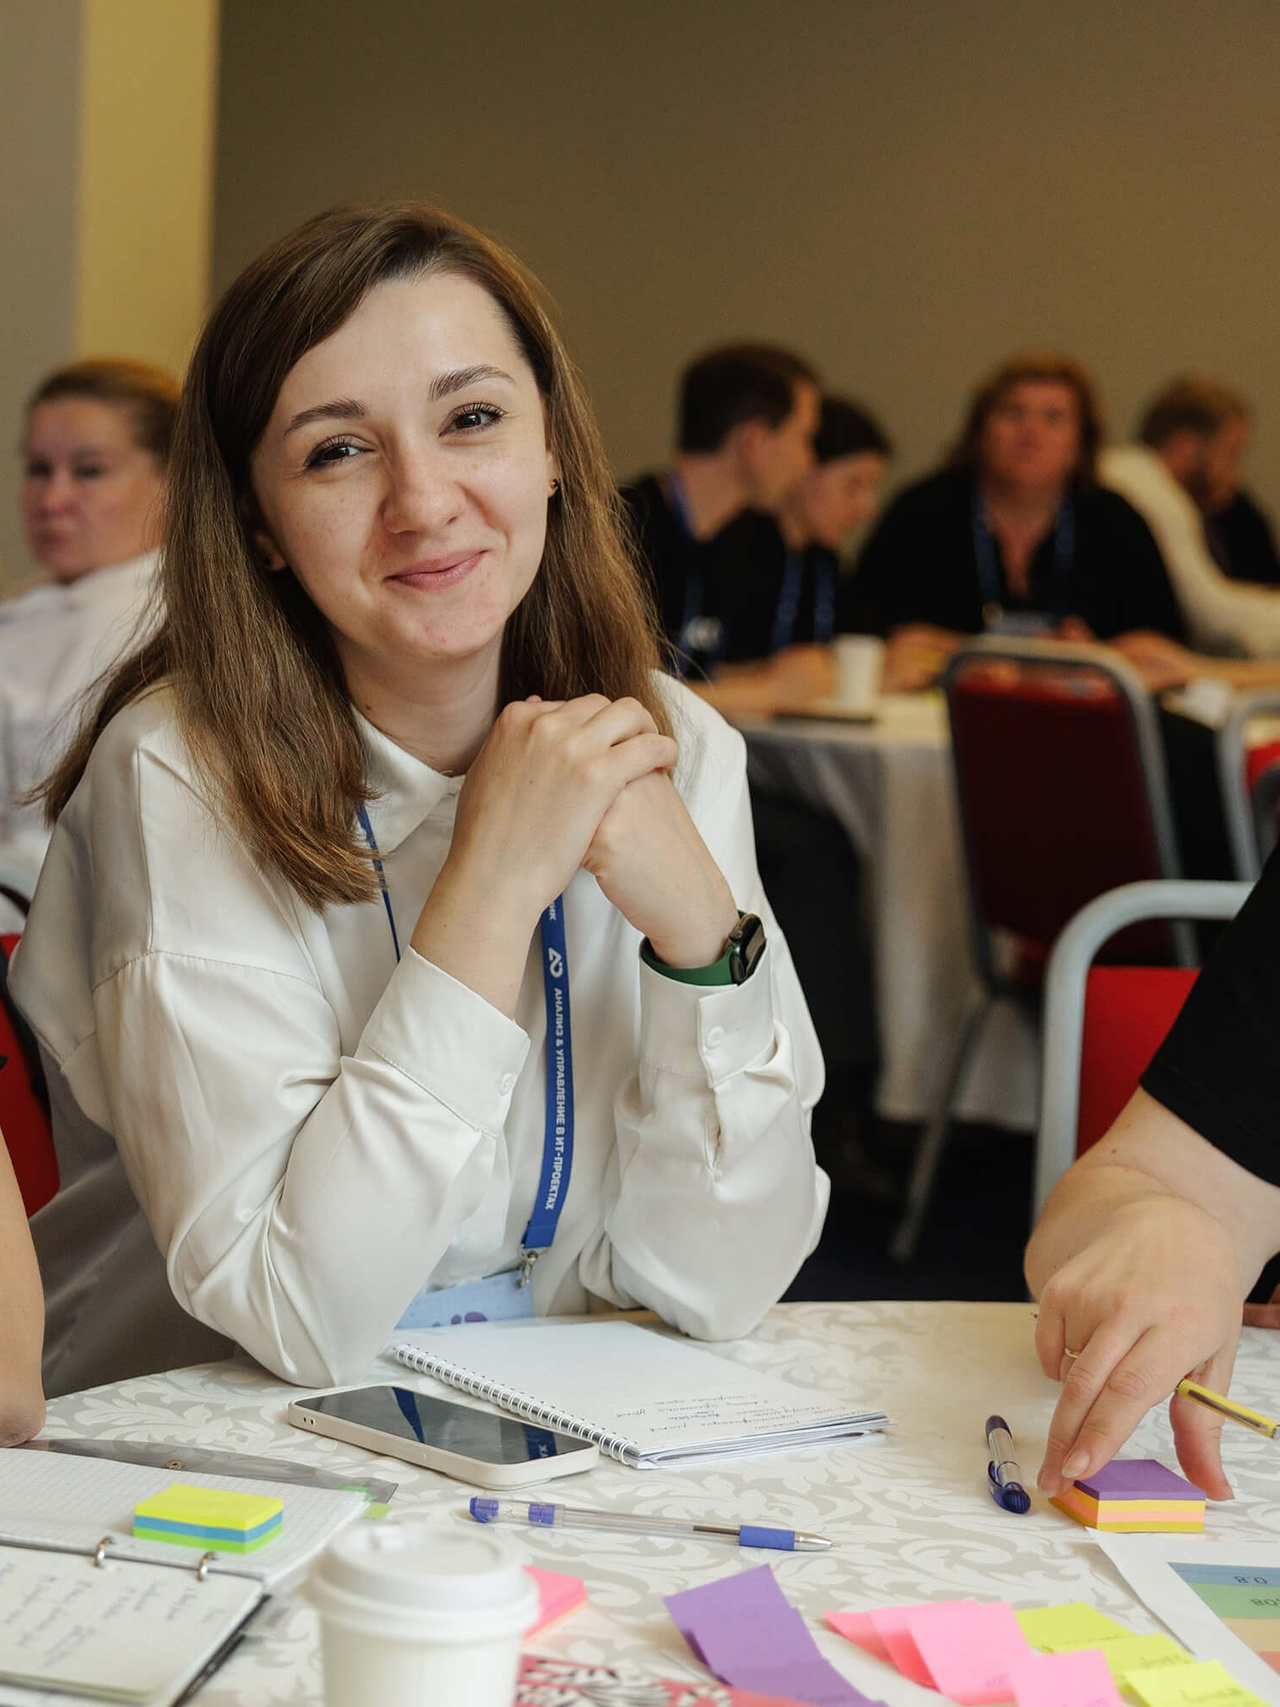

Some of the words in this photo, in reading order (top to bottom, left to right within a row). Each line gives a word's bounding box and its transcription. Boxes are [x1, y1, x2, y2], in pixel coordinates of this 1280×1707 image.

[553, 987, 564, 1036] АНАЛИЗ
[555, 1049, 566, 1126] УПРАВЛЕНИЕ
[555, 1127, 566, 1135] В
[545, 1137, 566, 1210] ИТ-ПРОЕКТАХ
